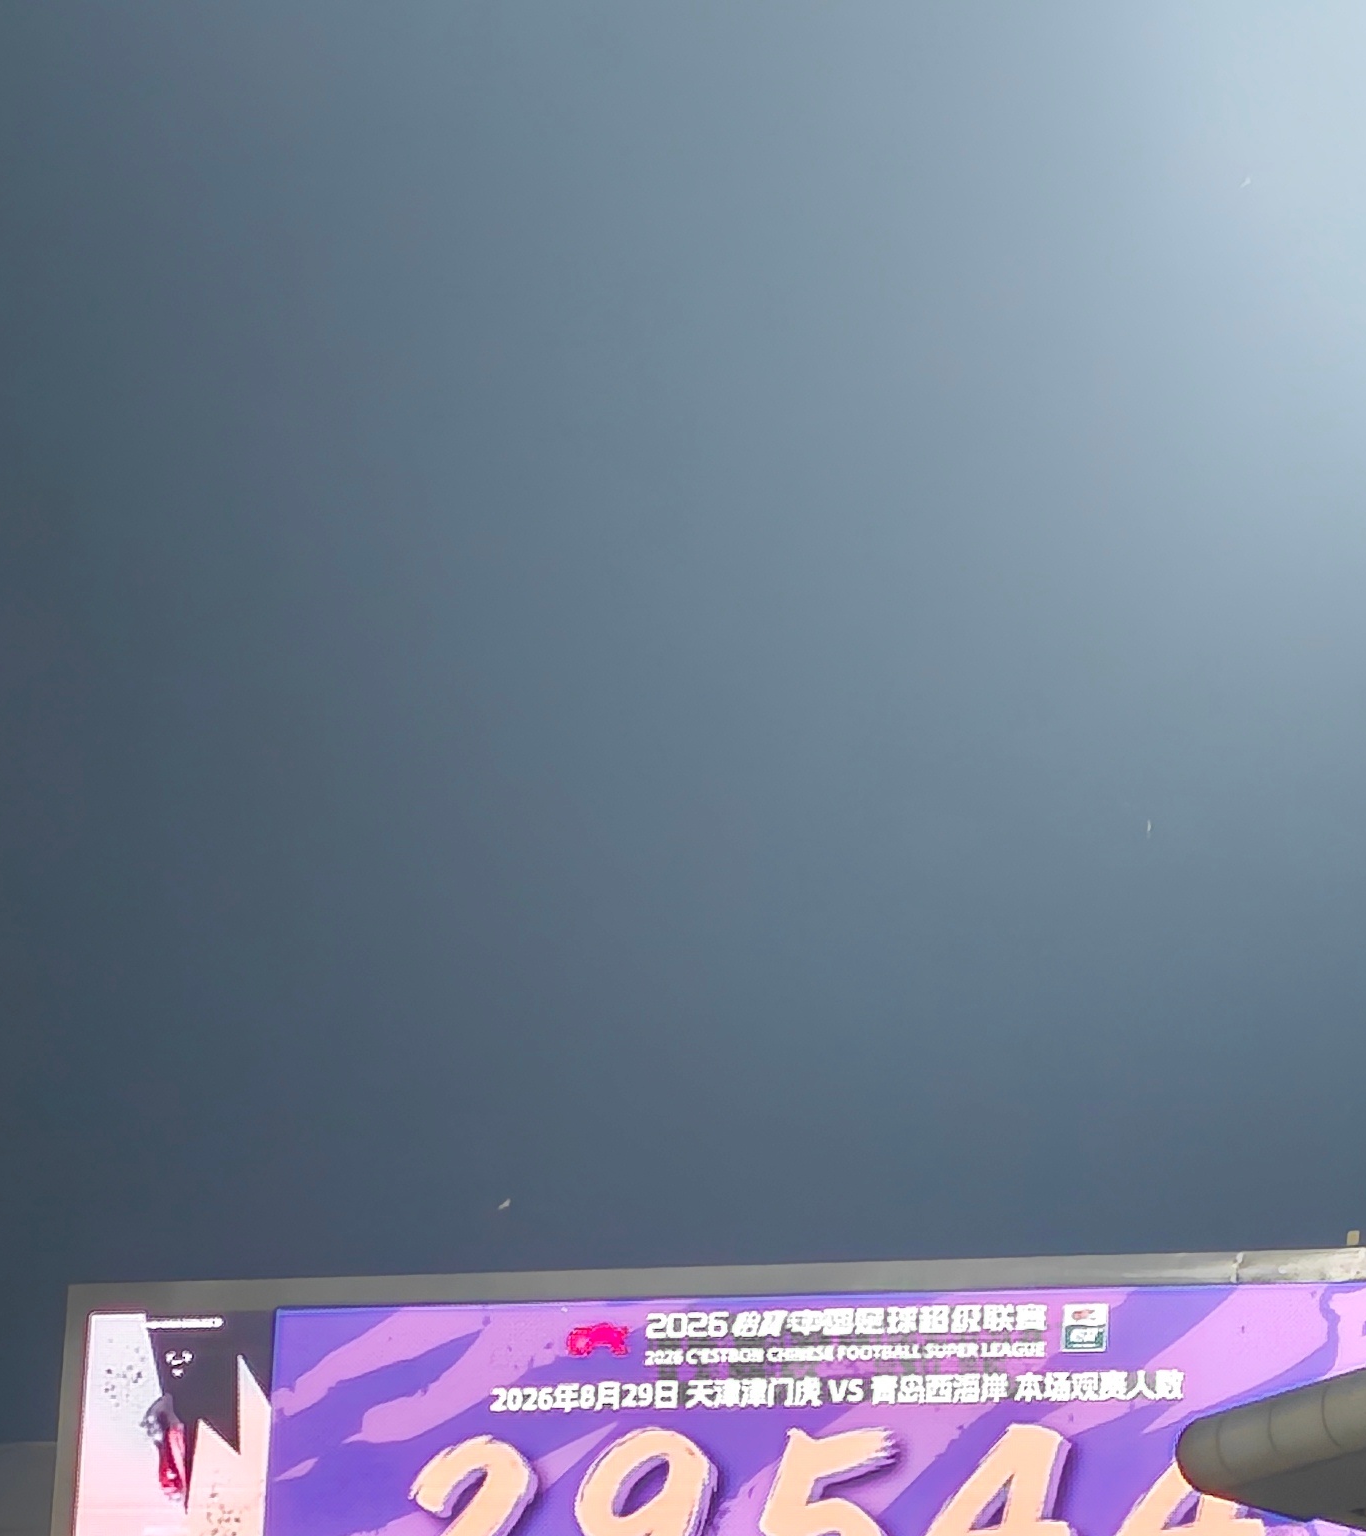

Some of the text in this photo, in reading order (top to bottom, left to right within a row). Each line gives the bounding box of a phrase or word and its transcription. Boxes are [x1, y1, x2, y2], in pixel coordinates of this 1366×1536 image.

[837, 1344, 921, 1361] FOOTBALL
[923, 1342, 979, 1359] SUPER
[980, 1341, 1047, 1358] LEAGUE
[489, 1368, 1185, 1413] 2026年8月29日 天津津门虎 VS 青岛西海岸 本场观赛人数
